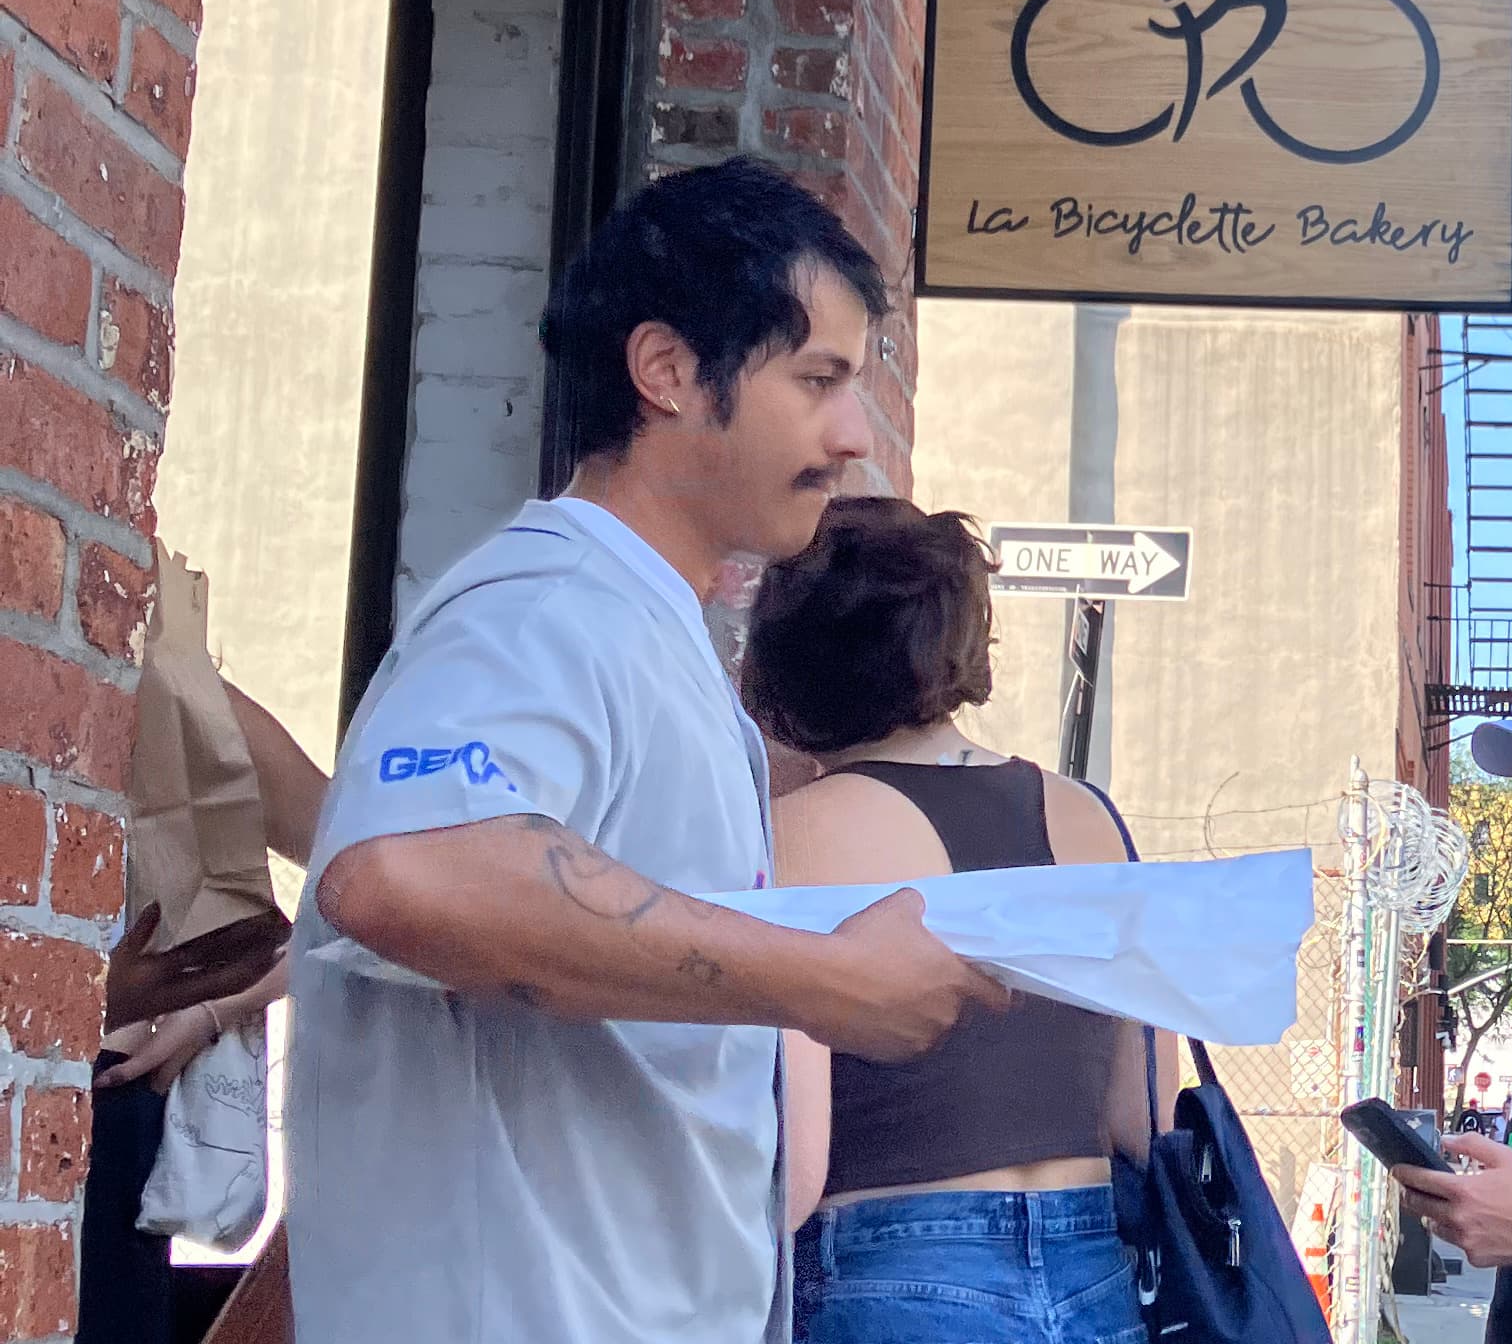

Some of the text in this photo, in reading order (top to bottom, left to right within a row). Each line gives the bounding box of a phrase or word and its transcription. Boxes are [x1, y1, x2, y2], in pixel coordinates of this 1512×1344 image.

[967, 192, 1474, 265] La Bicyclette Bakery
[1016, 547, 1159, 576] ONE WAY
